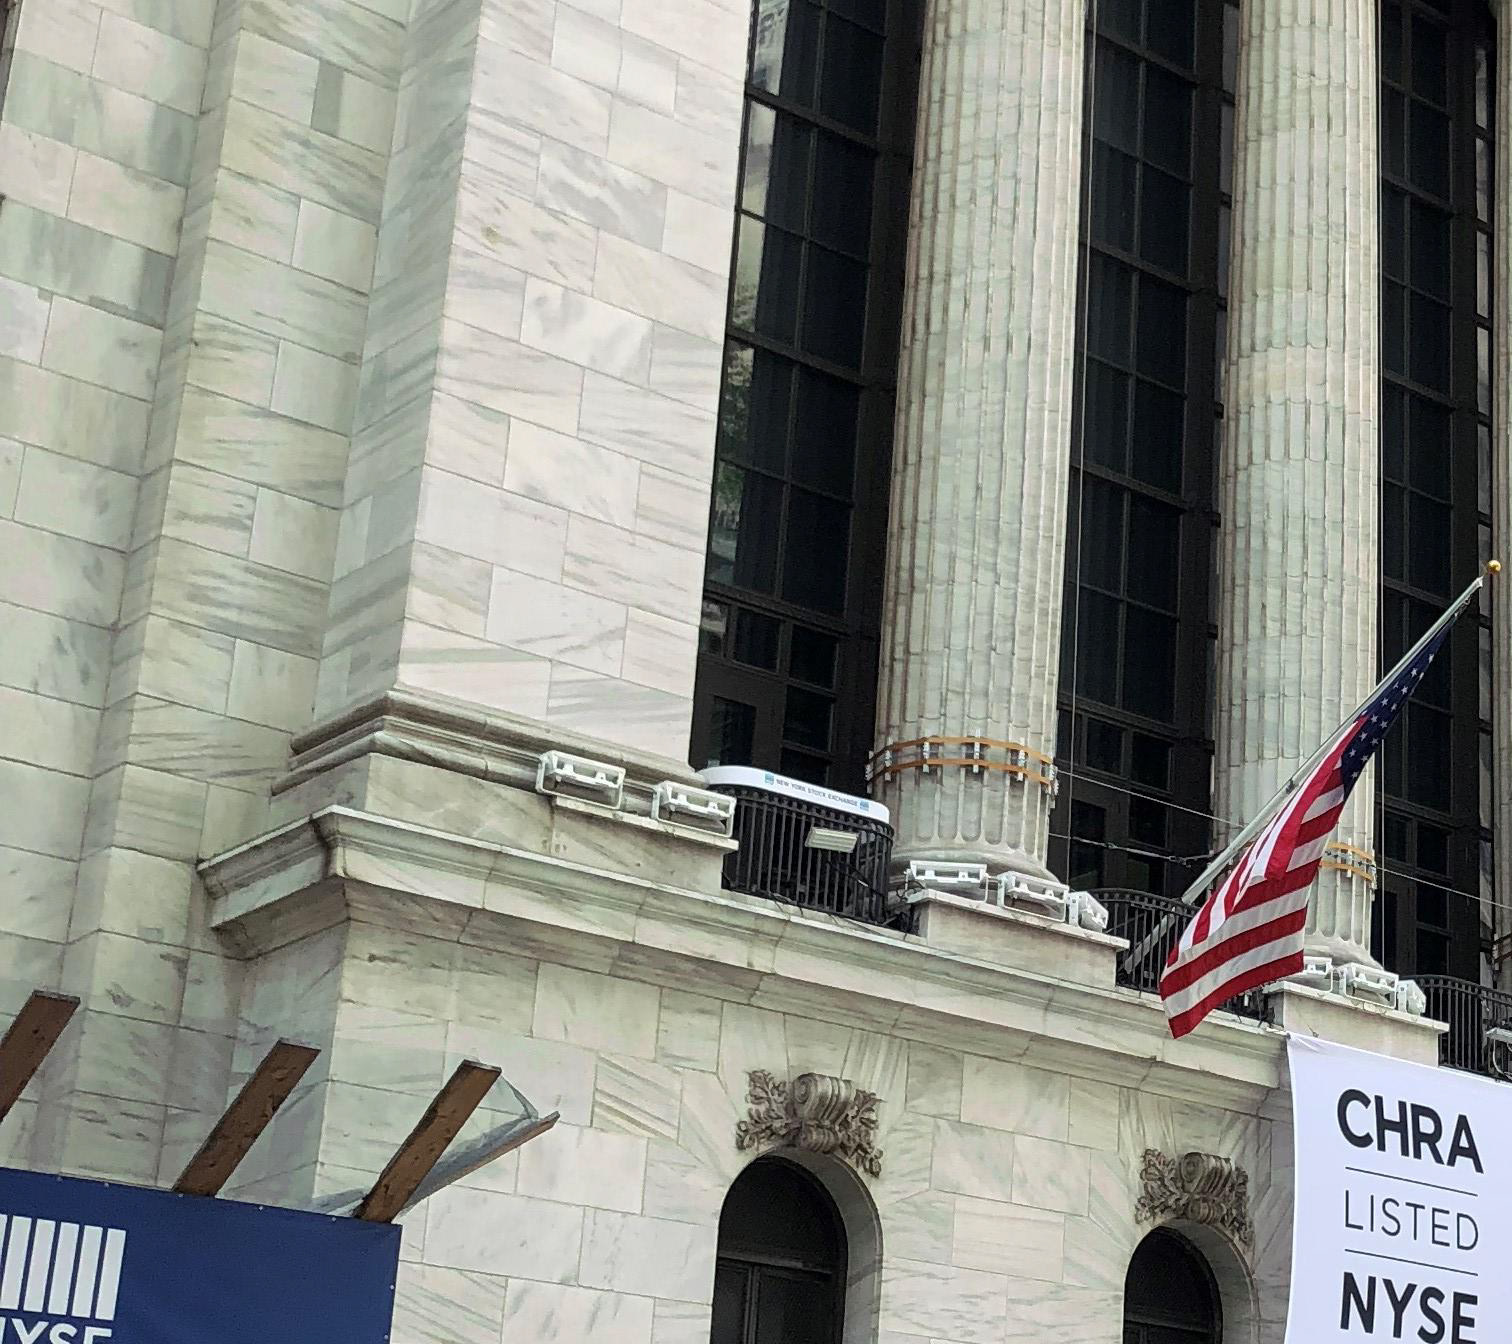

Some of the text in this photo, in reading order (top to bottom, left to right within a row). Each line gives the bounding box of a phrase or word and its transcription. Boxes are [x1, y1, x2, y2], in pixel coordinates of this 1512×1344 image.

[807, 787, 826, 797] STOCK
[1337, 1088, 1484, 1174] CHRA
[1344, 1190, 1479, 1251] LISTED
